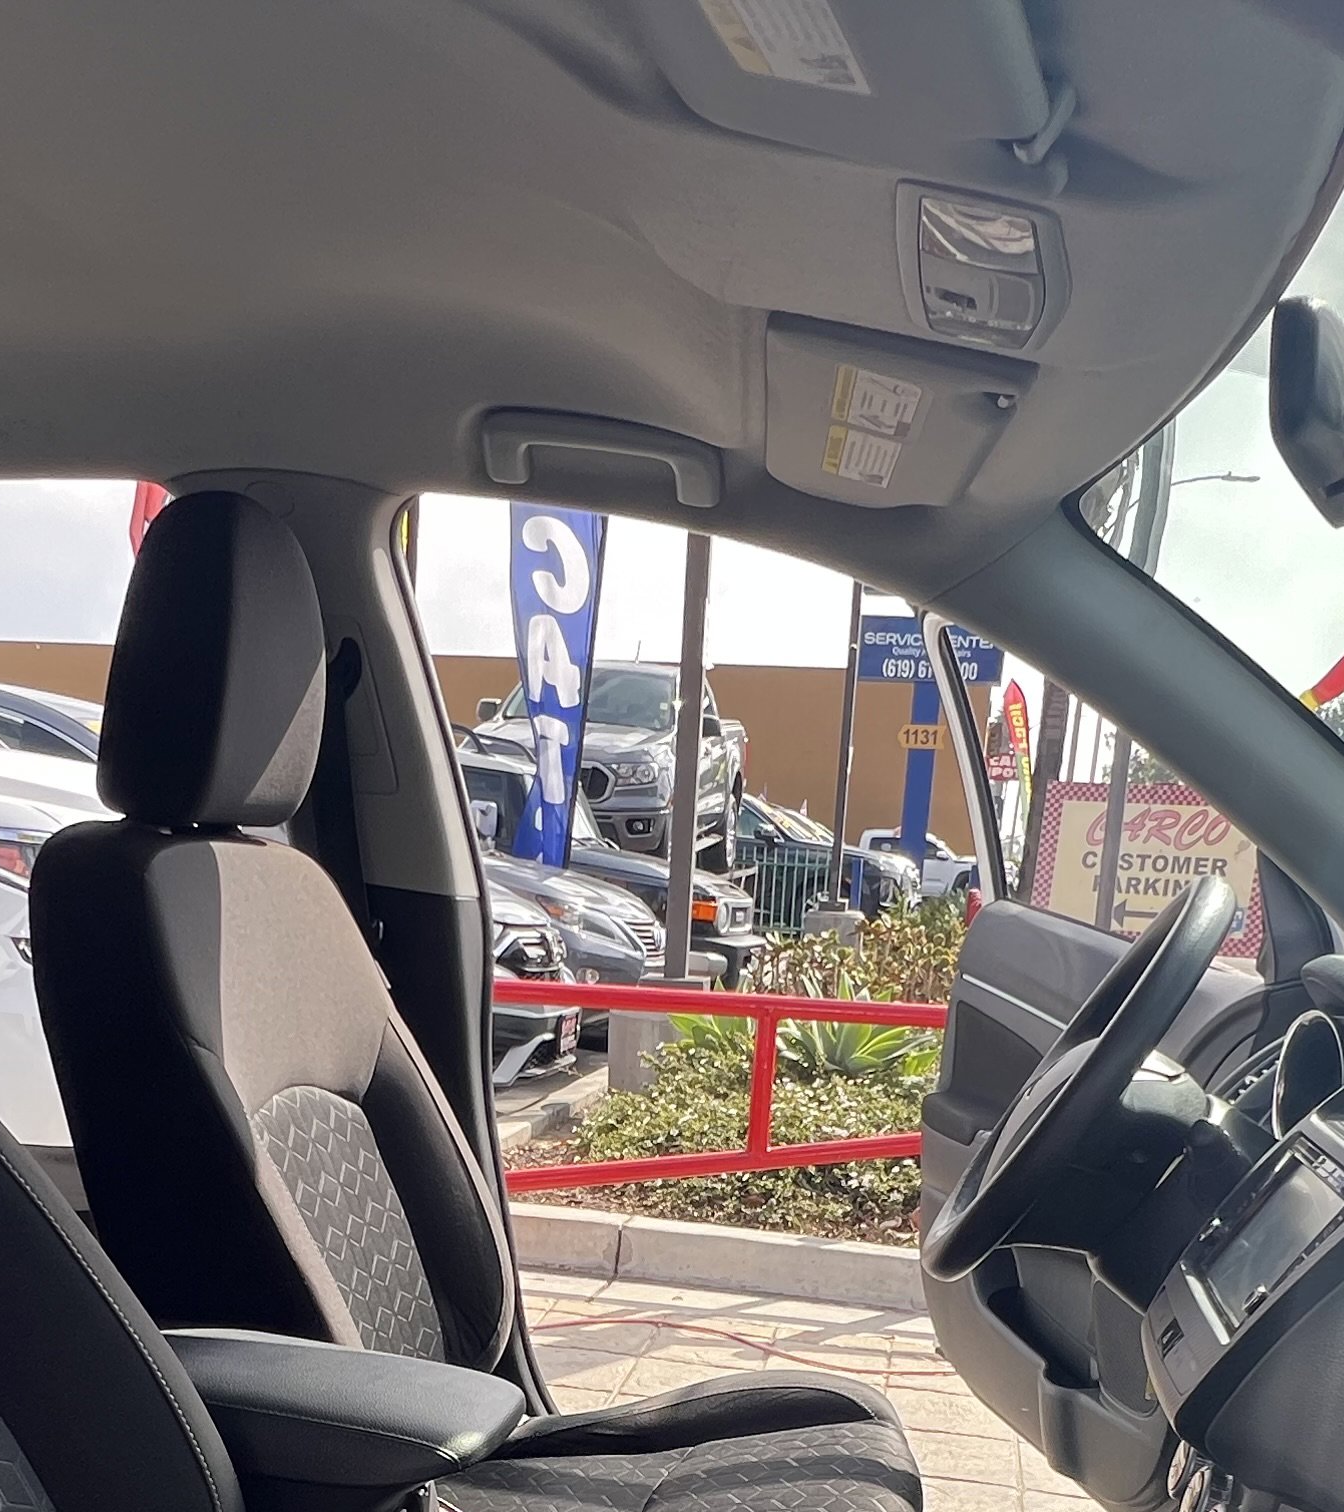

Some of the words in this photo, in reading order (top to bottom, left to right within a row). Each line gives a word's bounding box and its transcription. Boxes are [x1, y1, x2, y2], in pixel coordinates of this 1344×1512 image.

[864, 632, 923, 646] SERVIC
[882, 657, 914, 679] (619)
[903, 729, 938, 745] 1131
[1081, 851, 1228, 876] CSTOMER
